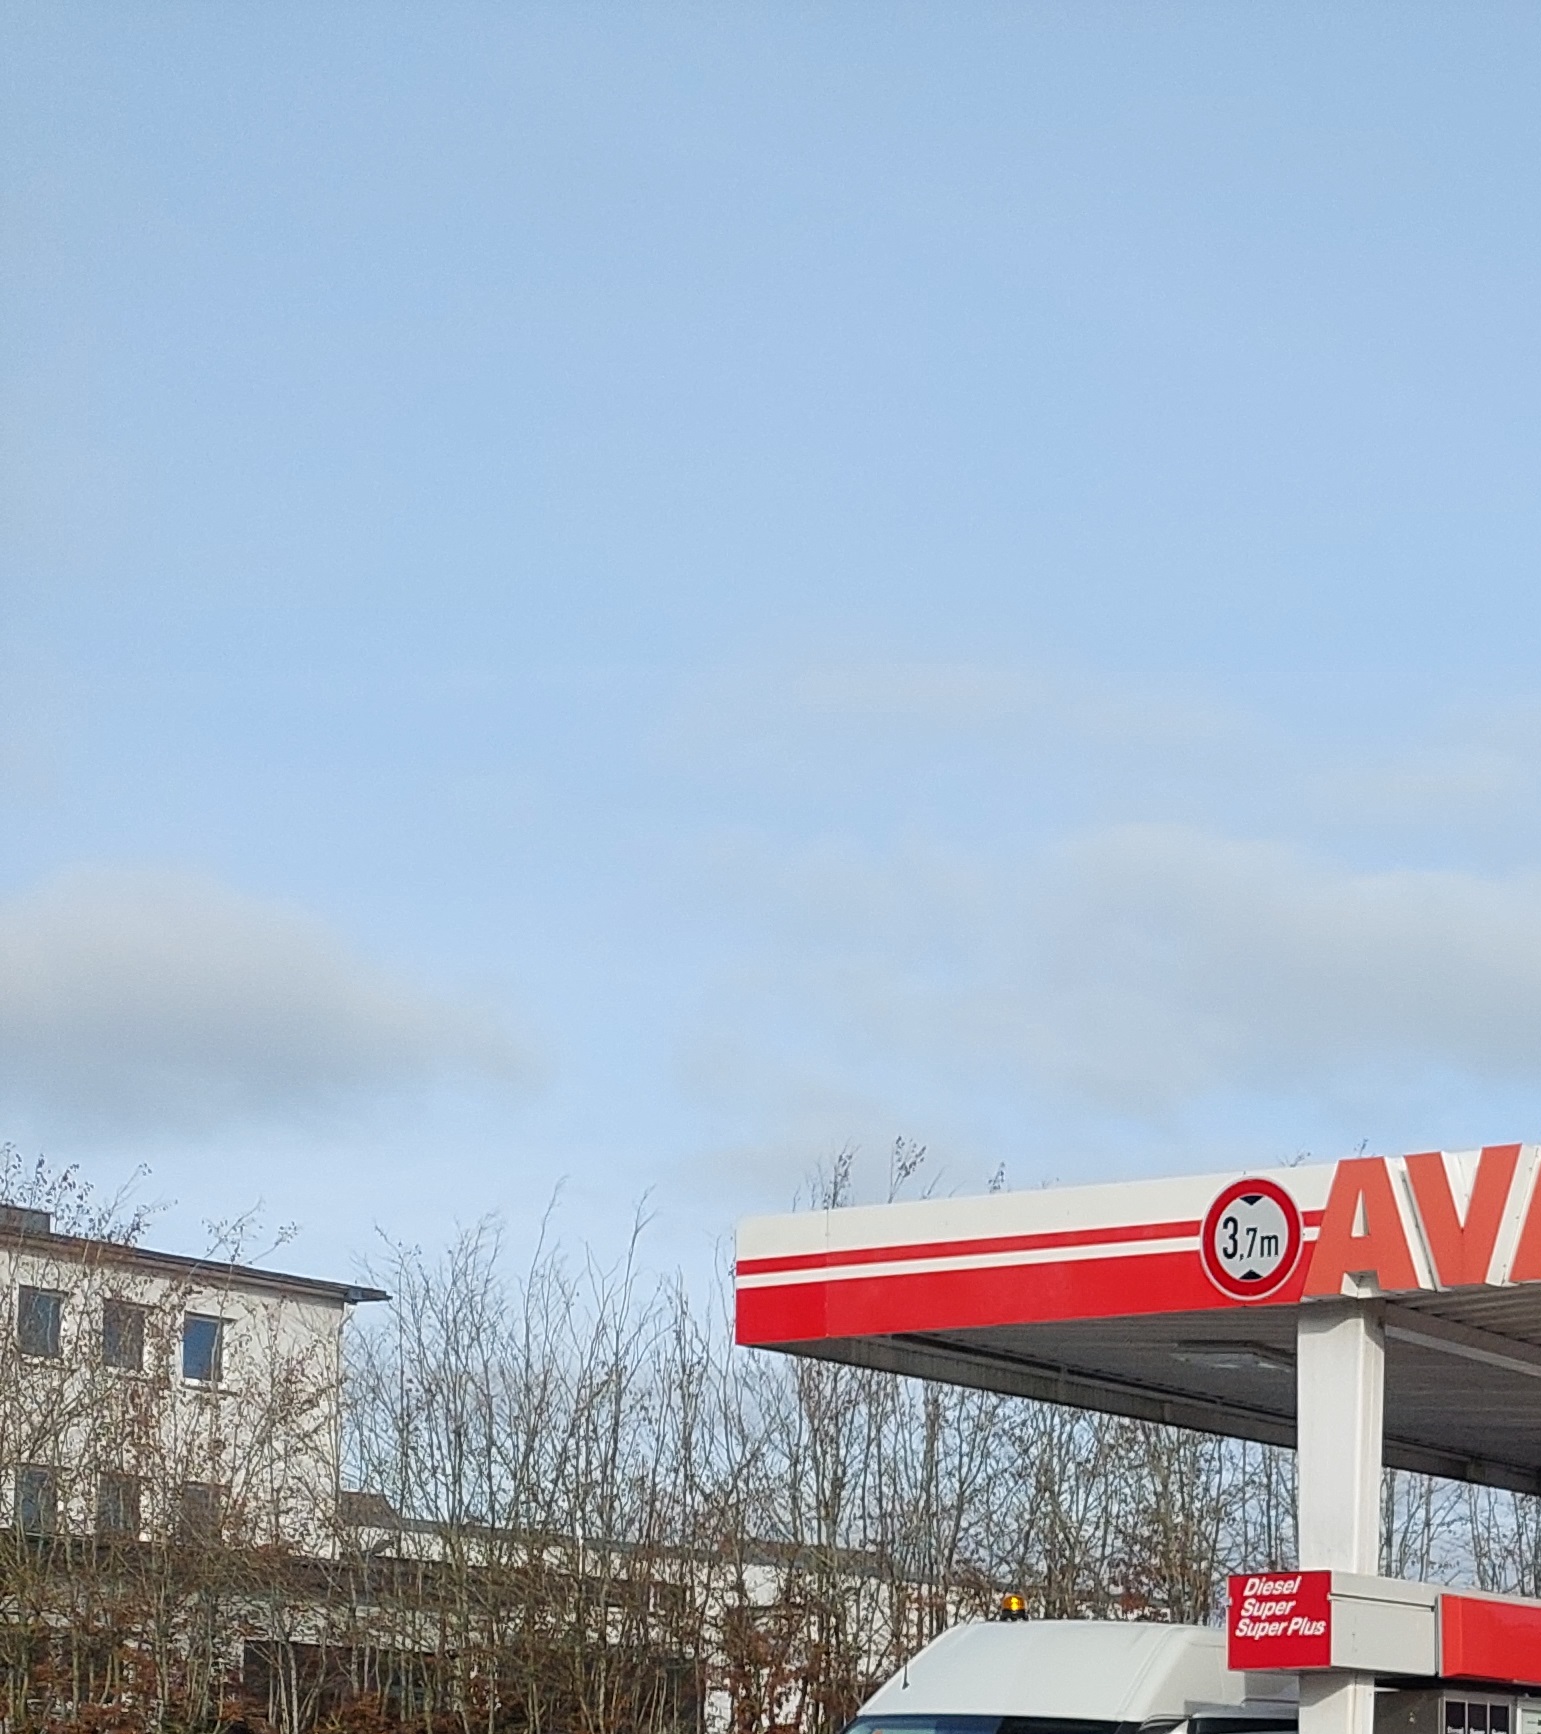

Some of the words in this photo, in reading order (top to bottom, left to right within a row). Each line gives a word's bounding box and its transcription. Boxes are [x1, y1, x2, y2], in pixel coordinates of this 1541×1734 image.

[1243, 1576, 1302, 1597] Diesel
[1240, 1597, 1297, 1620] Super
[1234, 1617, 1289, 1641] Super
[1287, 1616, 1327, 1637] Plus
